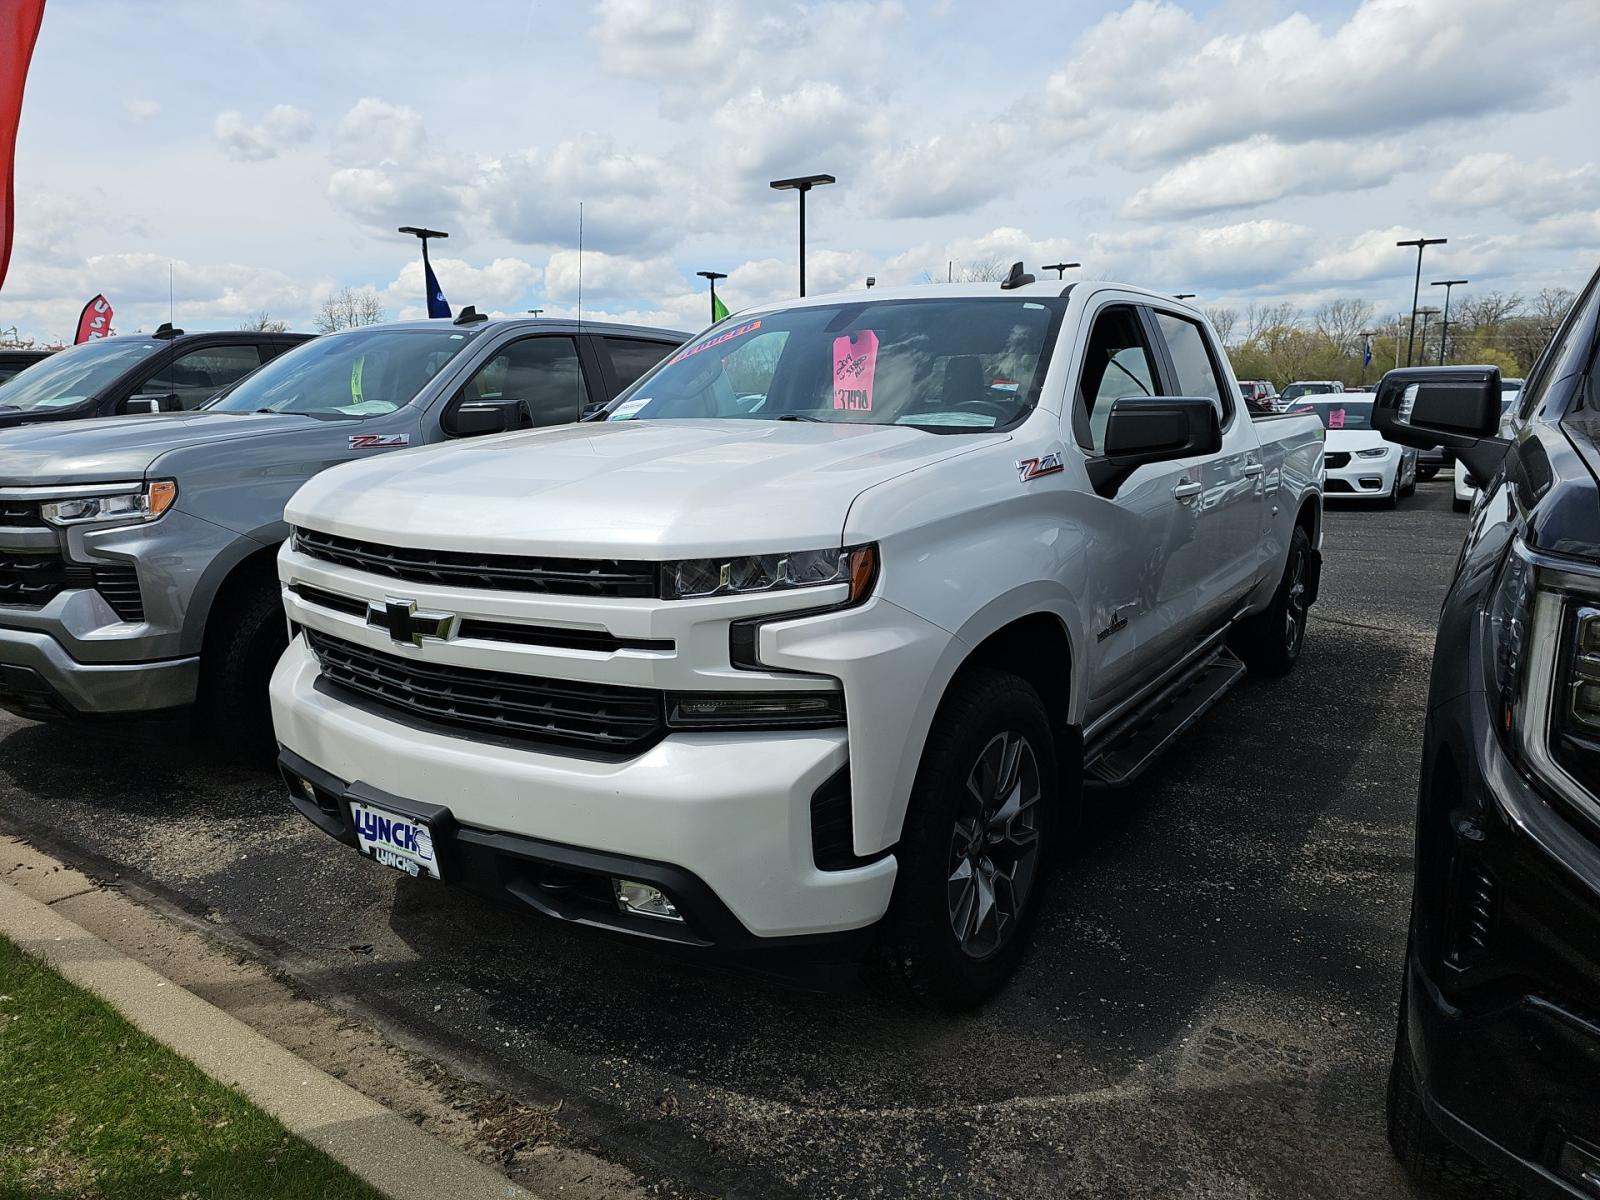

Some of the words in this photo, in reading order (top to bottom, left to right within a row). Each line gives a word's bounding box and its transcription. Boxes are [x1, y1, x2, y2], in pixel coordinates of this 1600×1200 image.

[1015, 451, 1064, 483] Z71
[355, 809, 418, 852] LYNCH
[375, 847, 412, 874] LYNCH
